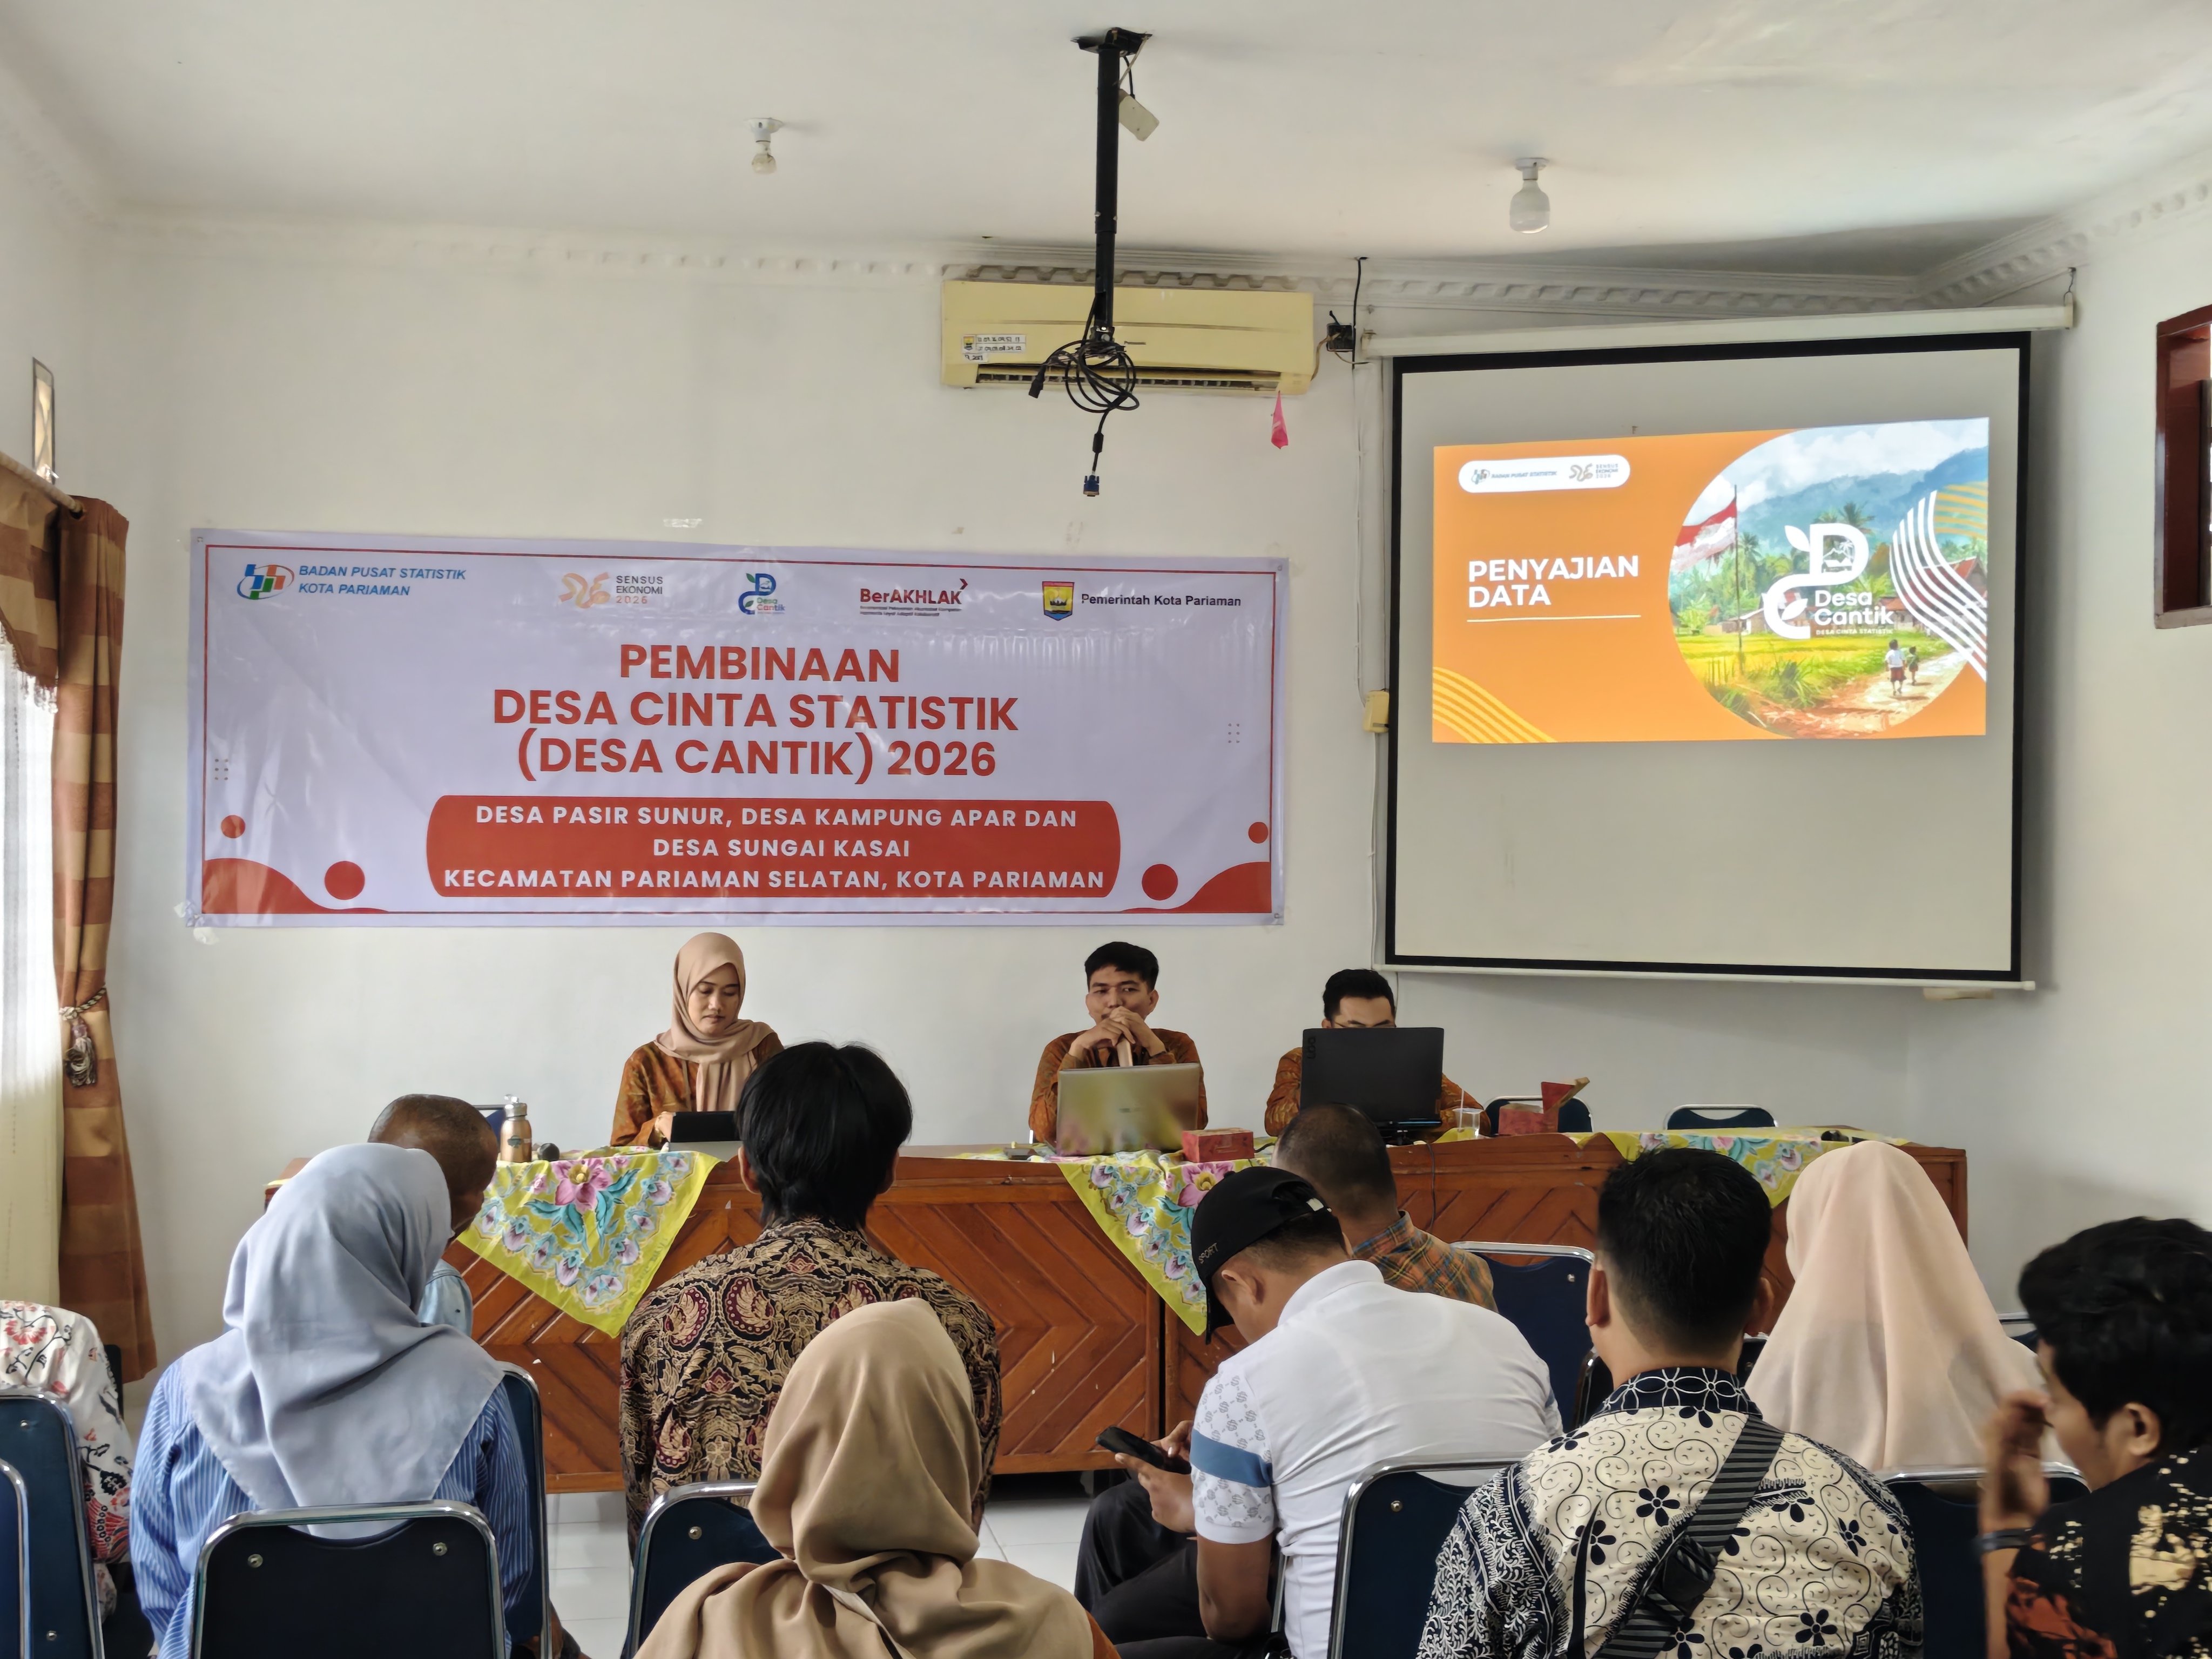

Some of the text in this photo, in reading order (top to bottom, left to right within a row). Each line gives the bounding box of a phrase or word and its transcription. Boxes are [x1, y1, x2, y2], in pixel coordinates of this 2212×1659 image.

[299, 565, 467, 579] BADAN PUSAT STATISTIK
[1469, 555, 1638, 582] PENYAJIAN
[616, 576, 663, 584] SENSUS
[299, 583, 410, 596] KOTA PARIAMAN
[616, 586, 663, 594] EKONOMI
[860, 588, 962, 604] BerAKHLAK
[1469, 584, 1552, 608] DATA
[1815, 590, 1872, 607] Desa
[616, 596, 648, 604] 2026
[1081, 594, 1241, 606] Pemerintah Kota Pariaman
[1814, 606, 1894, 625] Cantik
[621, 644, 899, 682] PEMBINAAN
[494, 689, 1019, 730] DESA CINTA STATISTIK
[518, 728, 996, 784] (DESA CANTIK) 2026
[476, 805, 1076, 828] DESA PASIR SUNUR, DESA KAMPUNG APAR DAN
[654, 839, 909, 857] DESA SUNGAI KASAI
[444, 869, 1104, 891] KECAMATAN PARIAMAN SELATAN, KOTA PARIAMAN
[1198, 1243, 1218, 1264] SPORT
